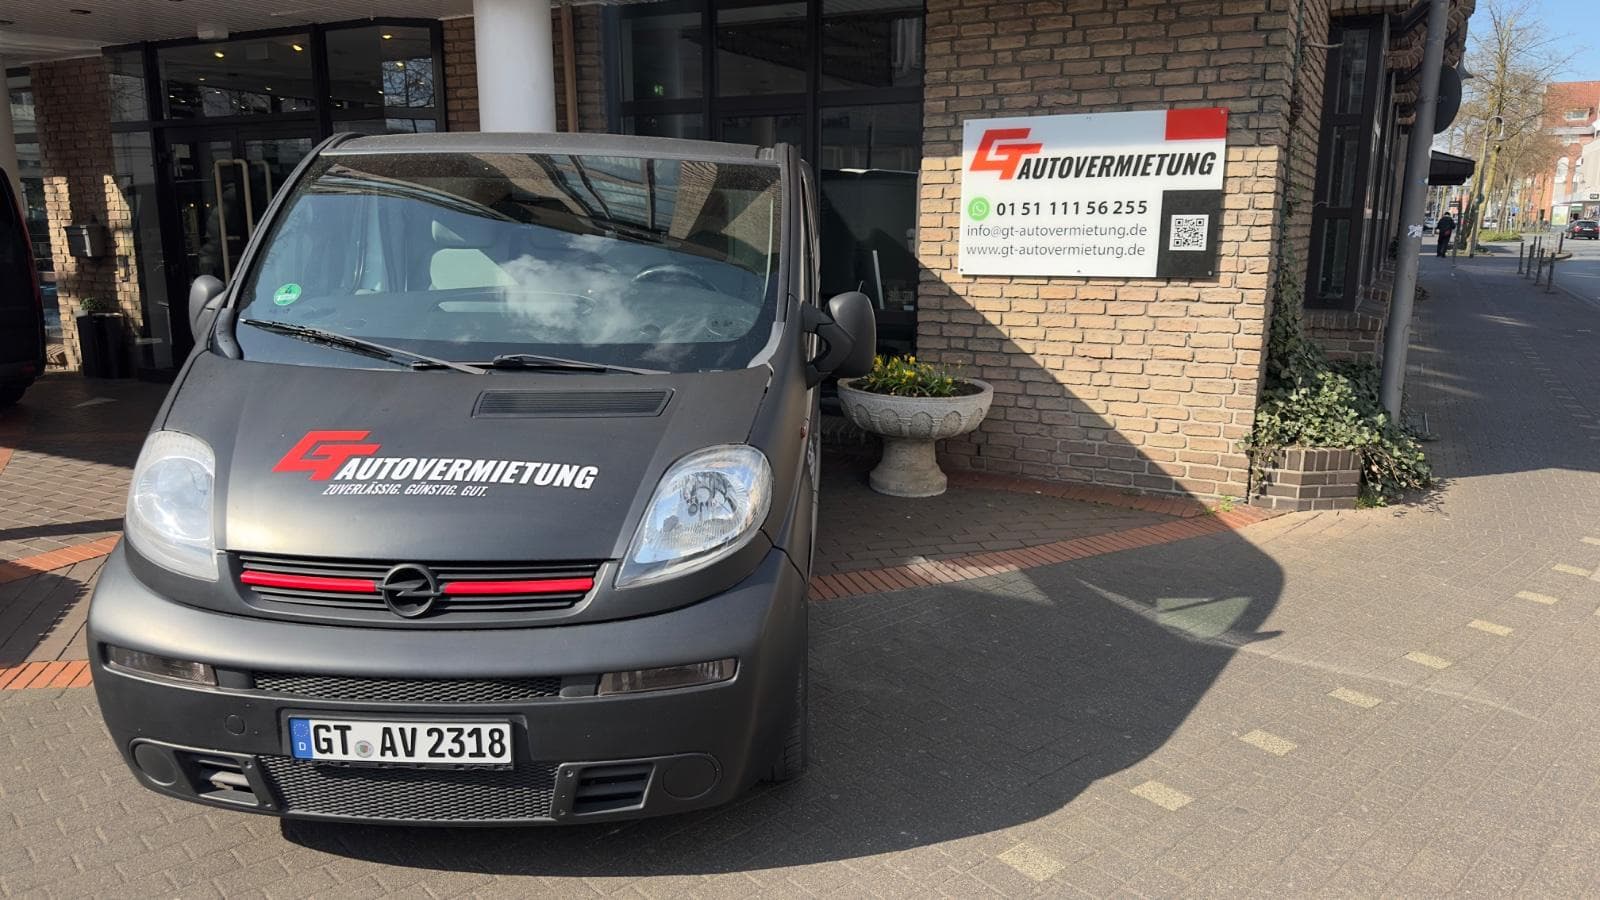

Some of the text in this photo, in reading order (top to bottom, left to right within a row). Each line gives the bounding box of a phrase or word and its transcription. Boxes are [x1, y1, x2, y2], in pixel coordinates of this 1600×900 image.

[969, 128, 1217, 180] GT AUTOVERMIETUNG
[967, 223, 1148, 240] info@gt-autovermietung.de
[966, 242, 1146, 258] www.gt-autovermietung.de
[271, 430, 599, 490] GT AUTOVERMIETUNG
[322, 481, 489, 497] ZUVERLÄSSIG. GÜNSTIG. GUT.
[298, 741, 307, 751] D
[313, 724, 506, 759] GT AV 2318
